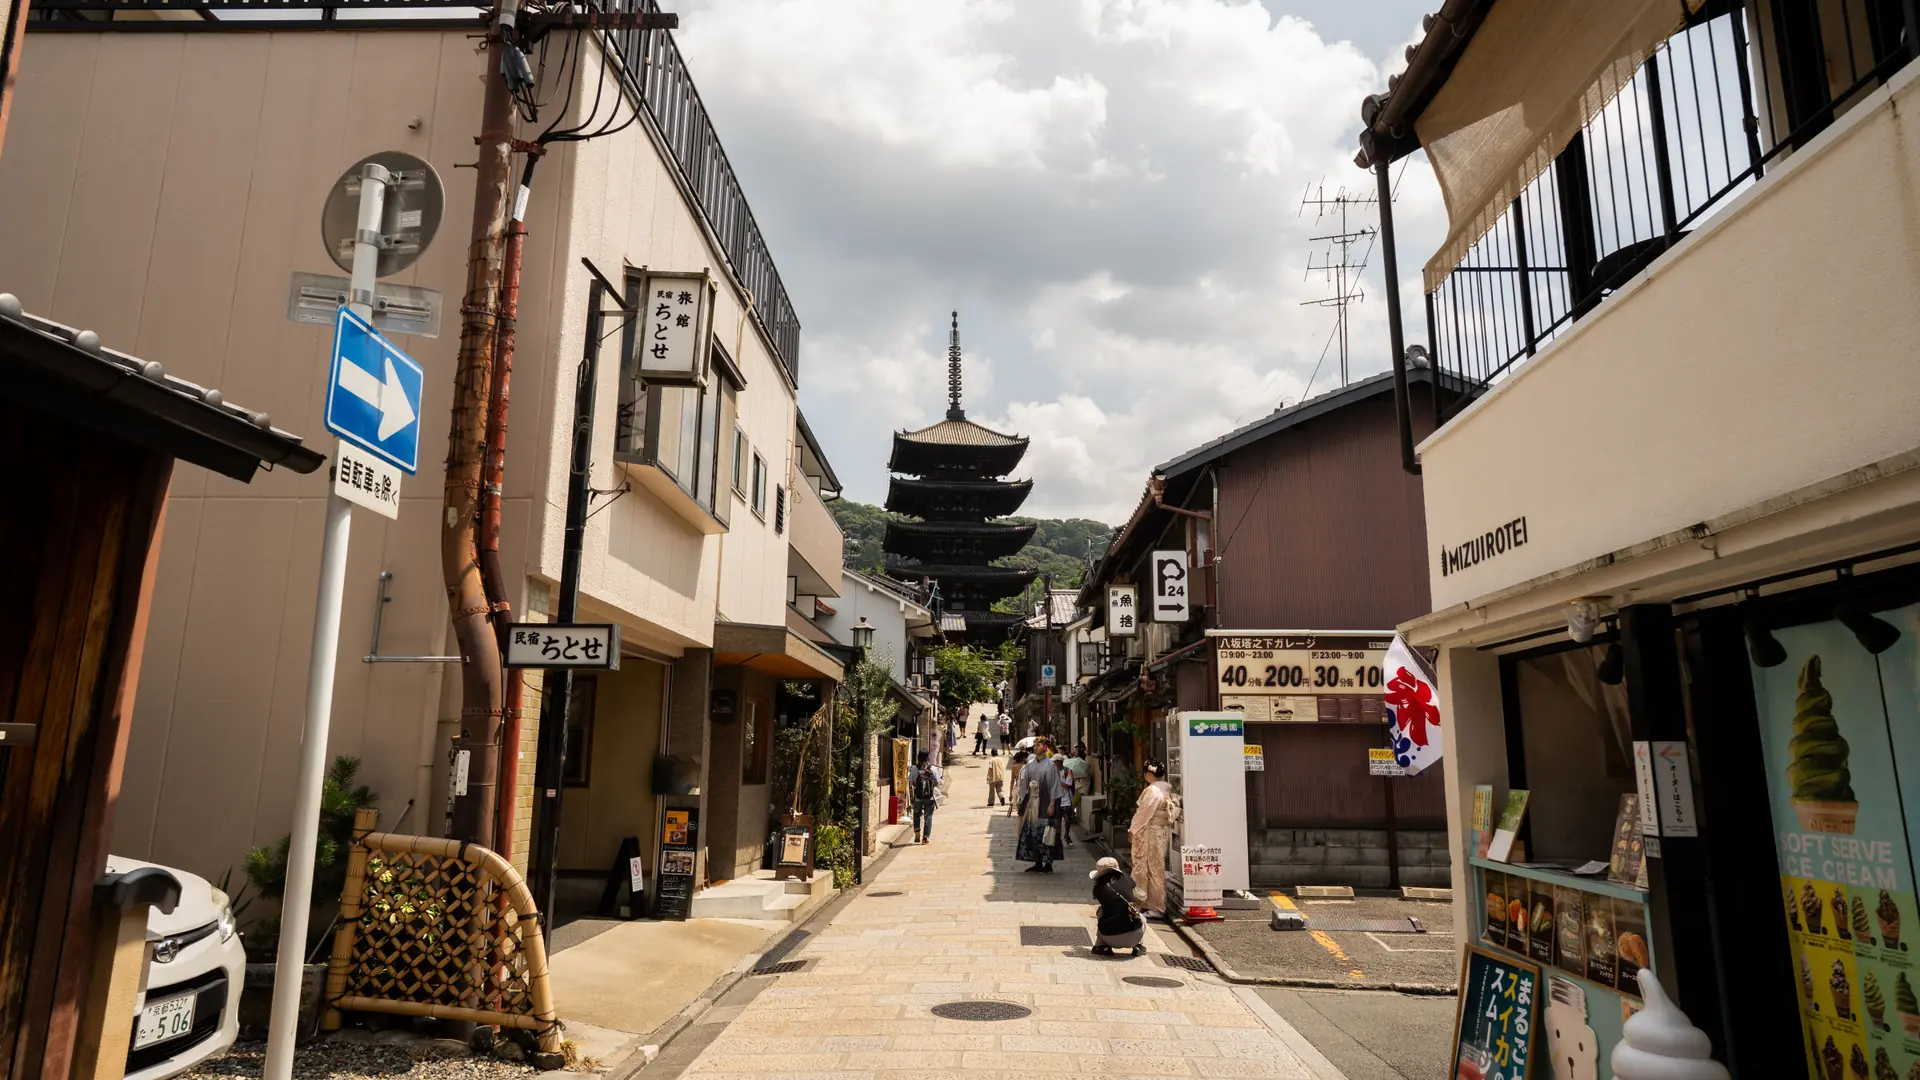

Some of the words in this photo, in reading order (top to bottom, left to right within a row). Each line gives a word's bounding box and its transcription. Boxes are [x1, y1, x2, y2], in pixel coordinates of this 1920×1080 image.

[656, 290, 674, 299] 民宿
[676, 291, 694, 328] 旅館
[650, 302, 672, 360] ちとせ
[340, 456, 397, 506] 自転車を除く
[1448, 515, 1528, 575] MIZUIROTEI
[514, 631, 541, 646] 民宿
[541, 635, 603, 661] ちとせ
[1219, 637, 1316, 650] 八坂塔之下ガレージ
[1210, 723, 1237, 732] 伊藤園
[1780, 832, 1825, 856] SOFT
[1831, 837, 1893, 864] SERVE
[1183, 863, 1221, 876] 禁止です
[1822, 860, 1897, 891] CREAM
